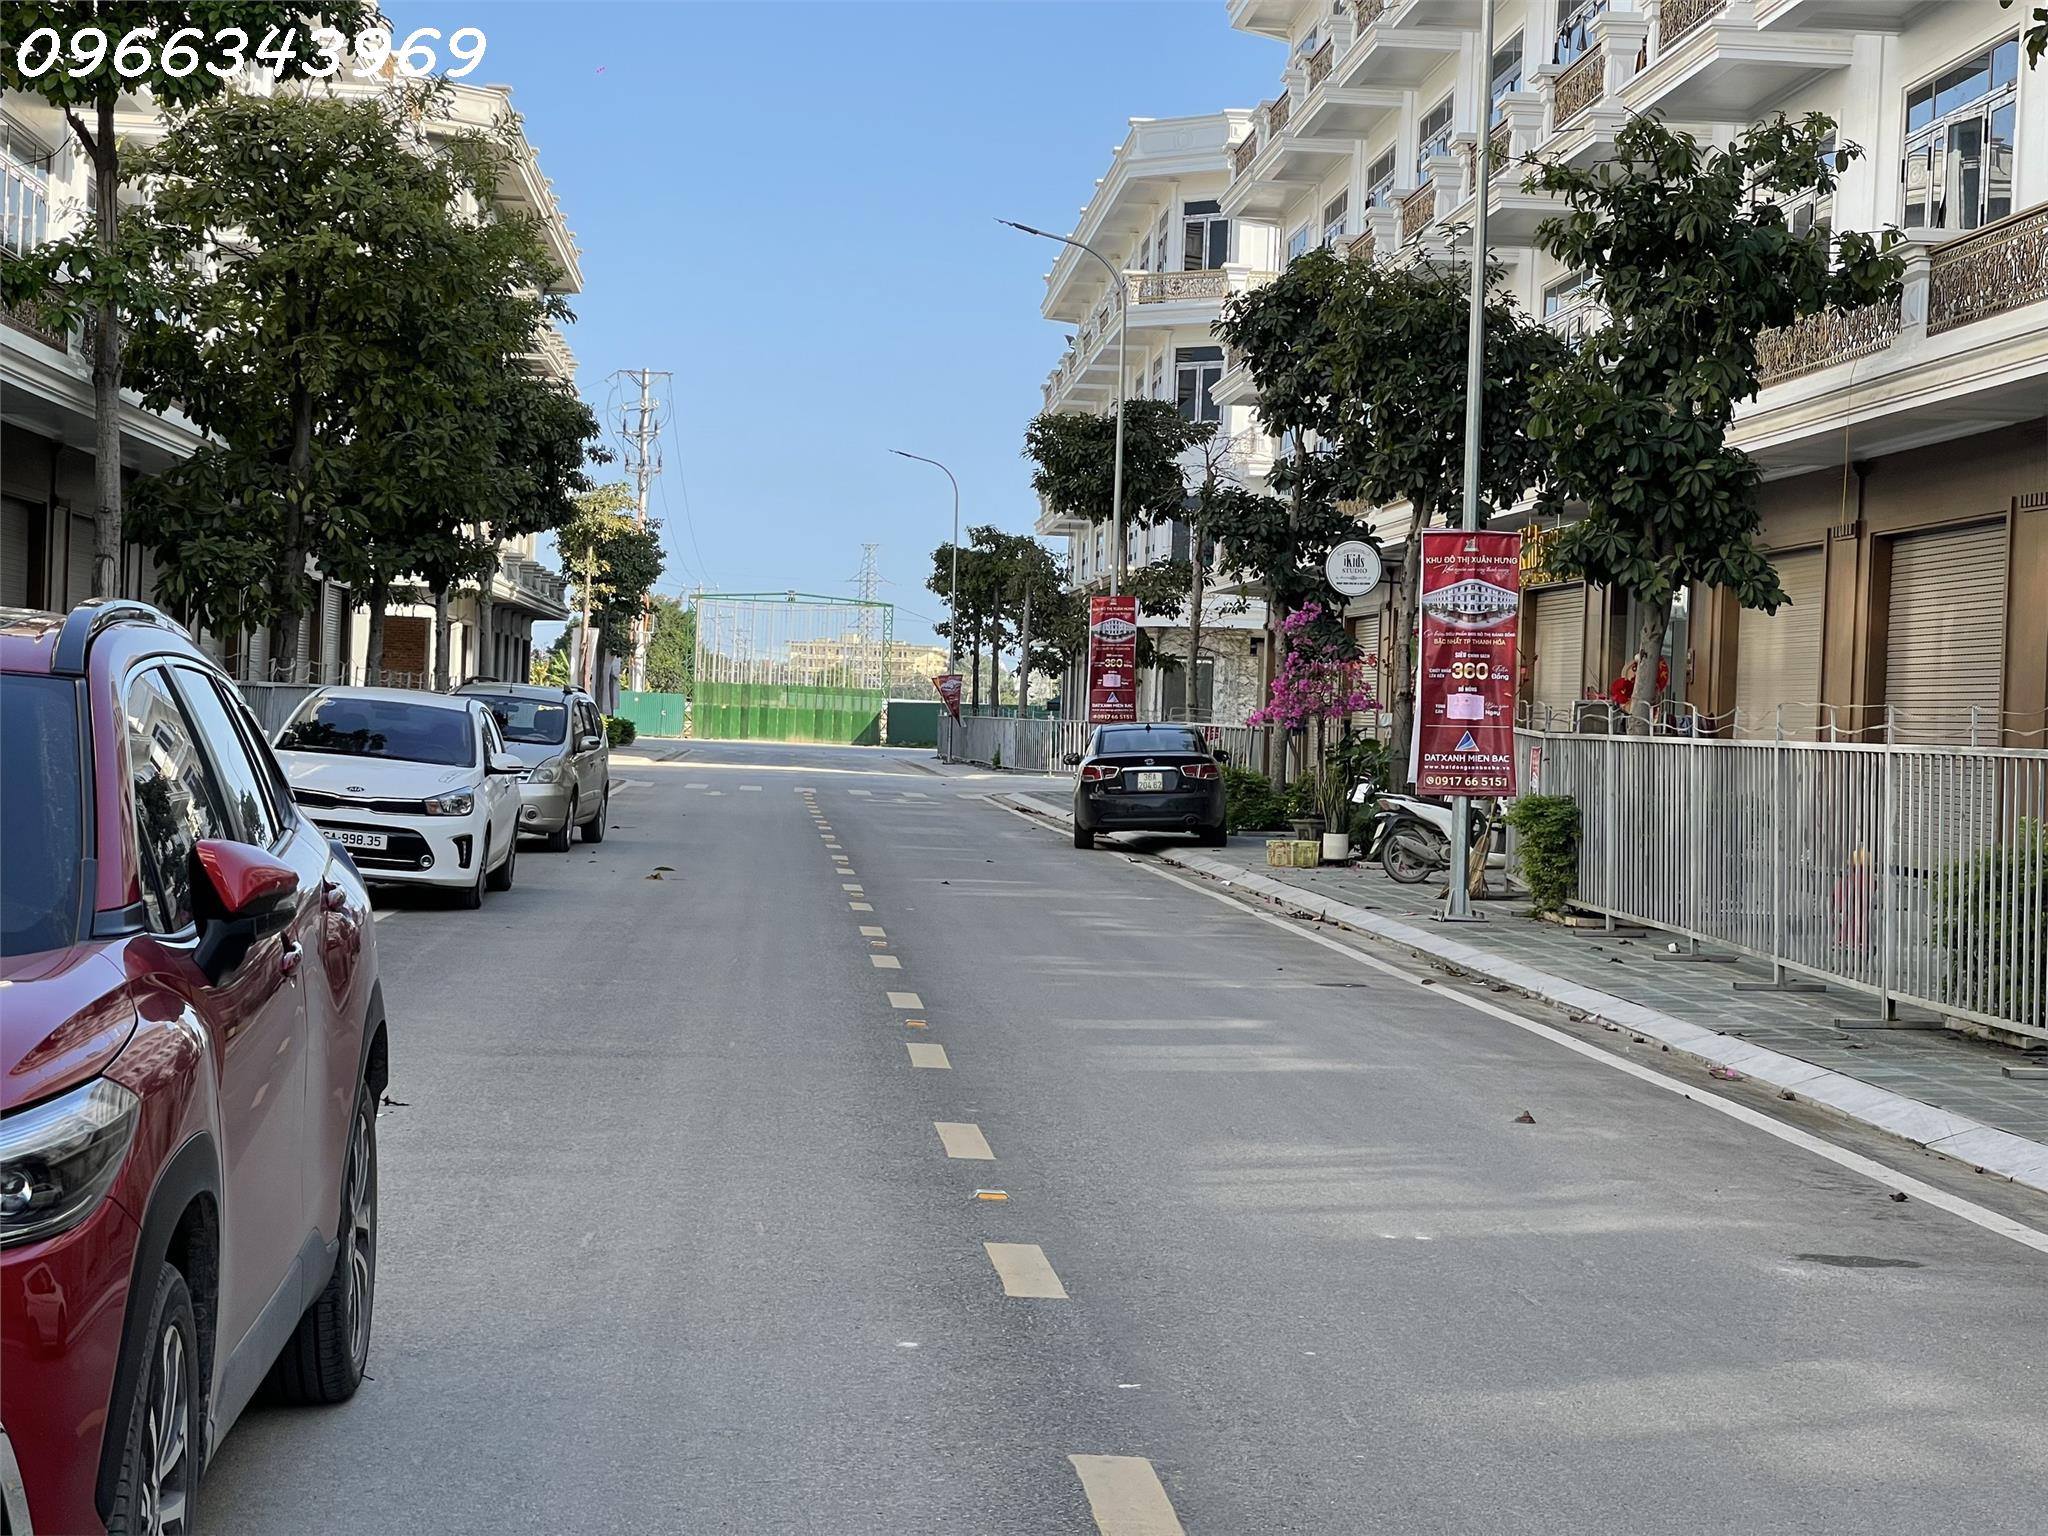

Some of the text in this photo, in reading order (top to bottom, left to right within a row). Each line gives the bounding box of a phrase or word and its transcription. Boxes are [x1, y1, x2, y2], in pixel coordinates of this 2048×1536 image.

[1343, 554, 1365, 568] iKids
[1443, 555, 1456, 564] ĐÔ
[1457, 556, 1470, 565] THỊ
[1471, 555, 1493, 564] XUÂN
[1447, 637, 1461, 645] NHẤT
[1451, 661, 1489, 680] 360
[1491, 673, 1509, 681] Đồng
[1424, 753, 1466, 762] DATXANH
[1468, 754, 1490, 762] MIEN
[1435, 776, 1508, 787] 0917 66 5151
